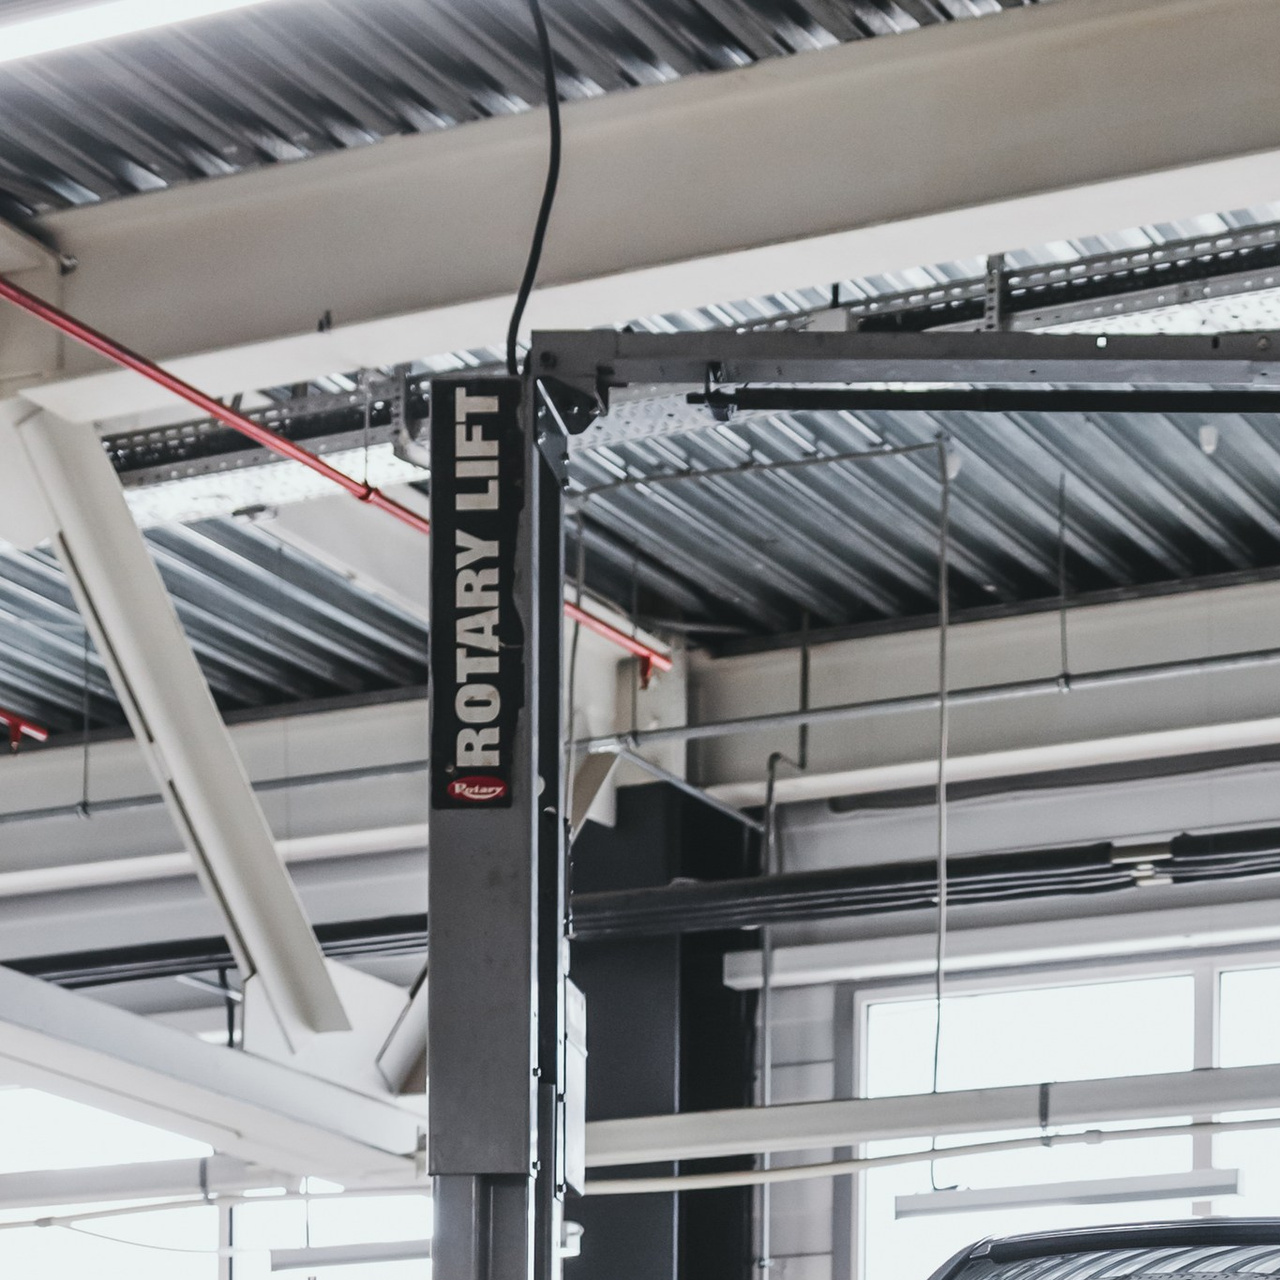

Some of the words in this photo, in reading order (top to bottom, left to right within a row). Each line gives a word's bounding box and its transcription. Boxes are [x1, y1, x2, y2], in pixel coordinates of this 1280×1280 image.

[454, 386, 500, 511] LIFT
[454, 529, 501, 767] ROTARY
[452, 781, 504, 800] Rotary
